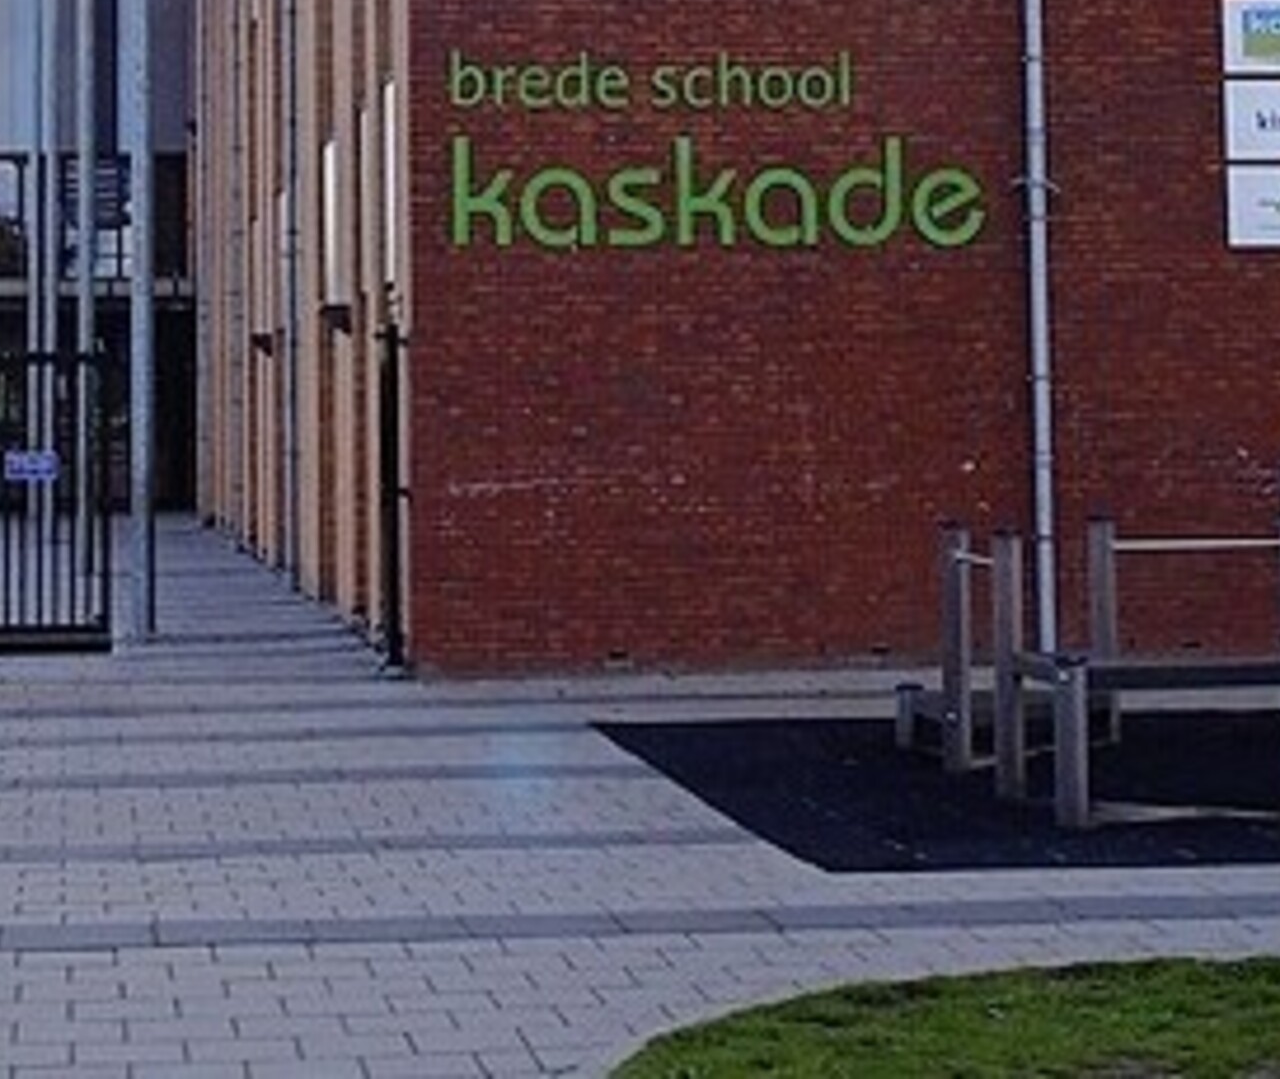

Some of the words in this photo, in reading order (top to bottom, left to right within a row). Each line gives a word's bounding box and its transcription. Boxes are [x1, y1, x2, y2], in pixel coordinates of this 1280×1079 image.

[449, 49, 629, 107] brede
[650, 49, 852, 107] school
[452, 134, 987, 247] kaskade
